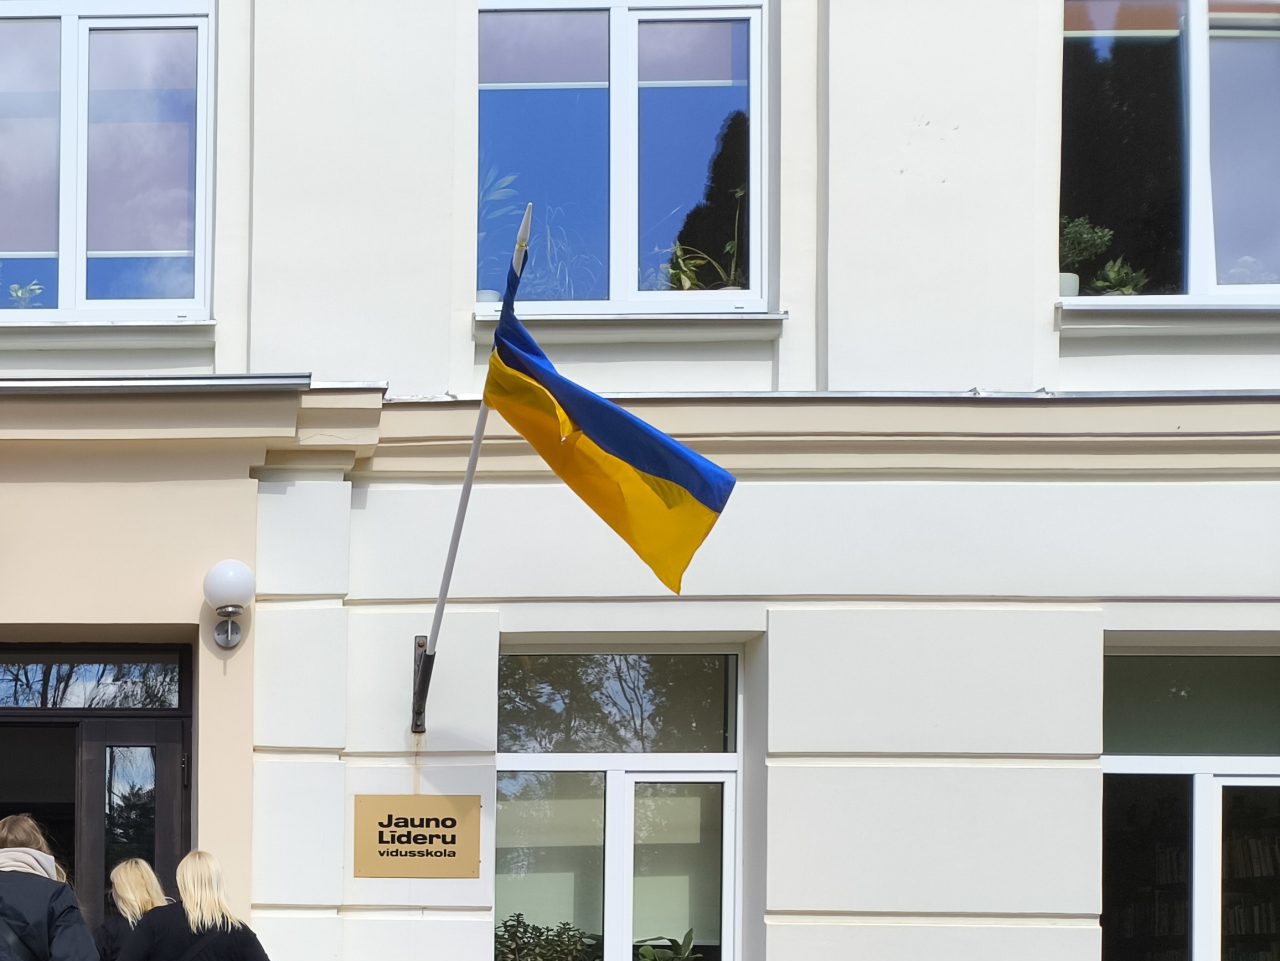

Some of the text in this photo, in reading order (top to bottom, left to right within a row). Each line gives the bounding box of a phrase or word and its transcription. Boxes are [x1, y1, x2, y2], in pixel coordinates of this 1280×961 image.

[378, 814, 457, 828] Jauno
[378, 831, 456, 845] Līderu
[378, 849, 456, 858] vidusskola
